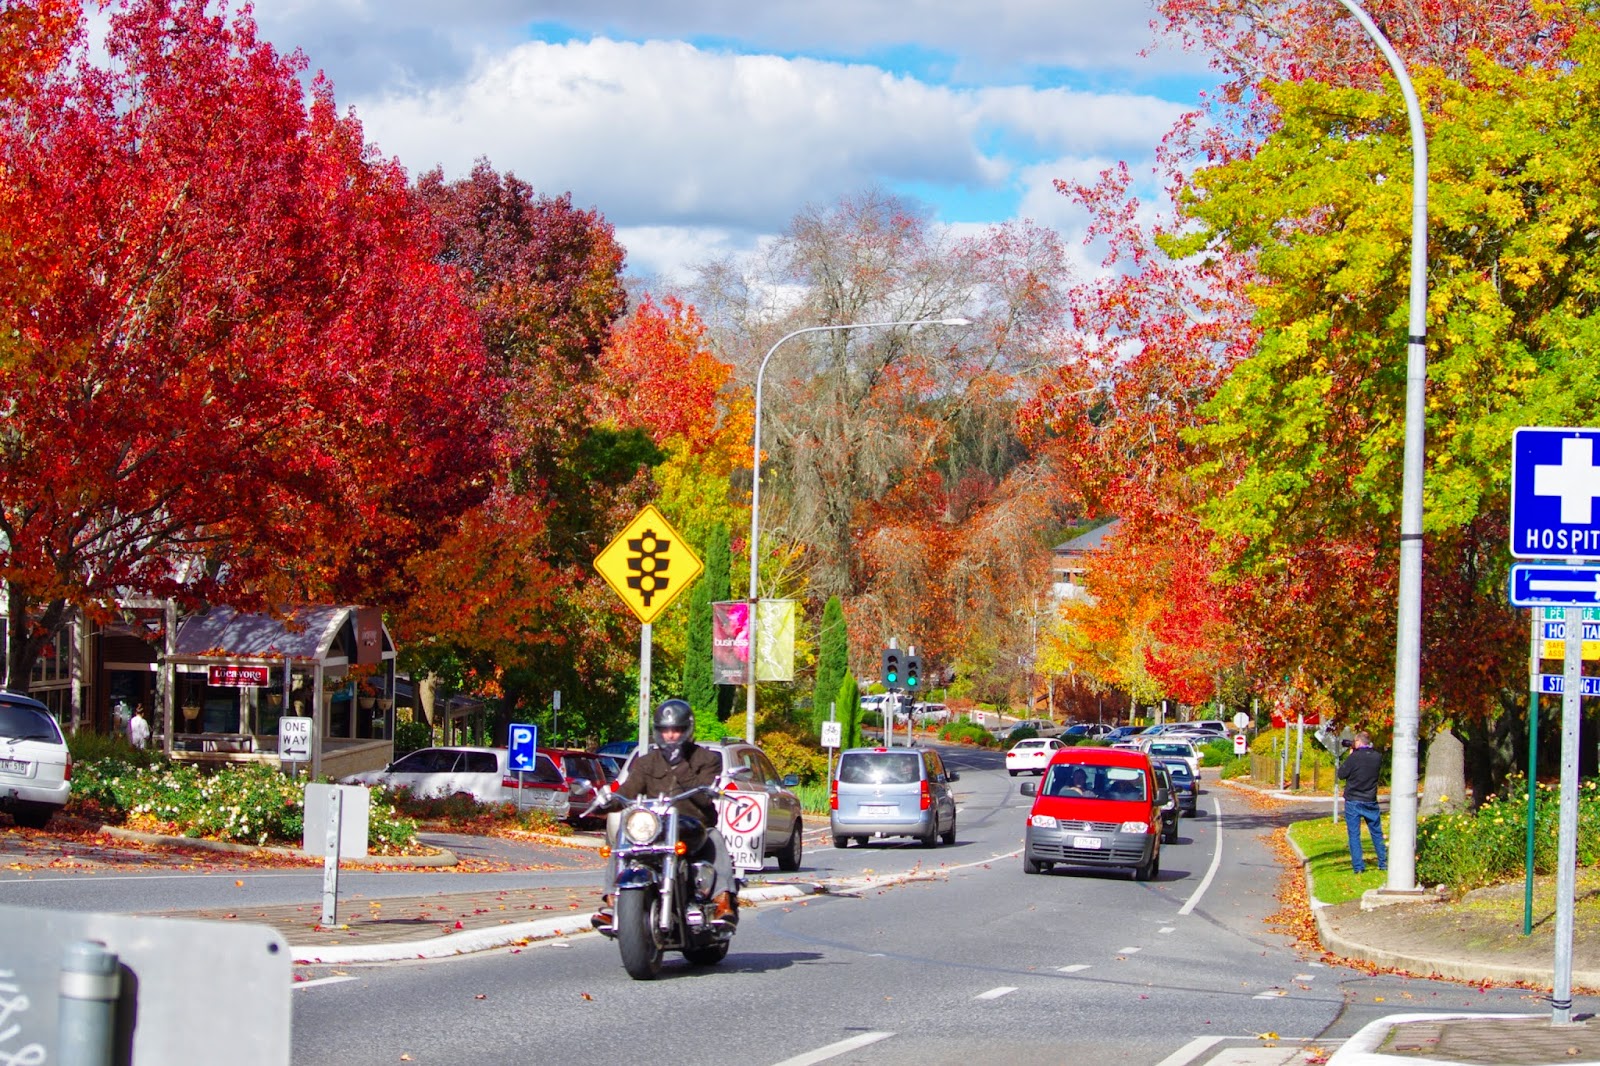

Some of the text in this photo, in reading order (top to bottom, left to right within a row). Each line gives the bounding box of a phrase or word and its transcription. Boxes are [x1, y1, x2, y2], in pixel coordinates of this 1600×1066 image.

[714, 637, 749, 647] business
[285, 722, 306, 732] ONE
[284, 735, 307, 745] WAY
[512, 728, 532, 750] P
[725, 835, 760, 850] NO U
[728, 852, 757, 864] URN
